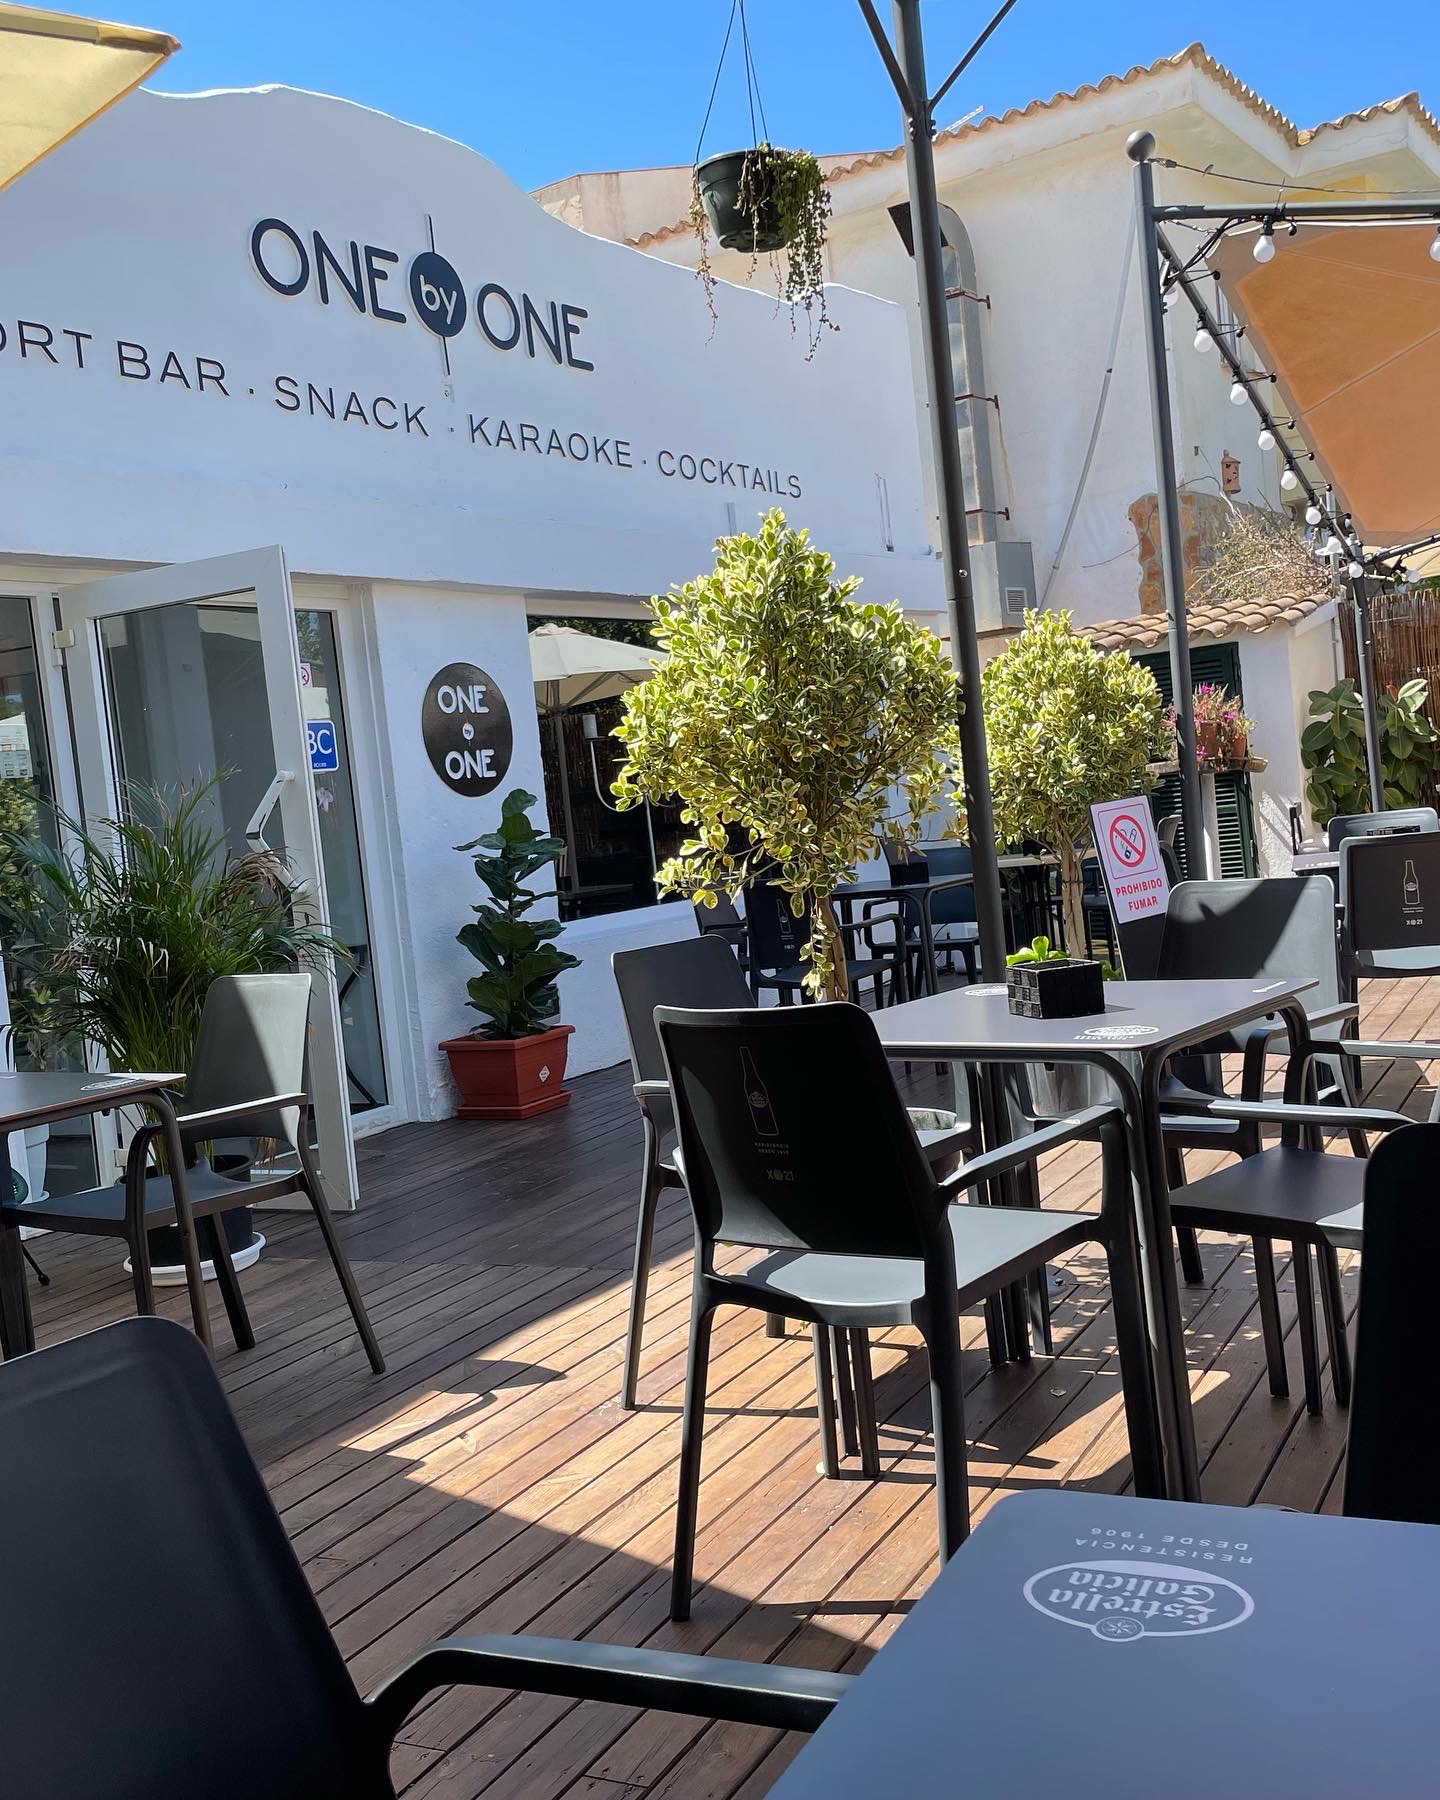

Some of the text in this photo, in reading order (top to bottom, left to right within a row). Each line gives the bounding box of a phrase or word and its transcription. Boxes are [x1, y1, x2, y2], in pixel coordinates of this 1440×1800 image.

[250, 217, 595, 372] ONE by ONE
[0, 319, 802, 499] RT BAR SNACK KARAOKE COCKTAILS
[437, 684, 490, 714] ONE
[445, 748, 497, 780] ONE
[1115, 878, 1163, 897] PROHIBIDO
[1128, 895, 1158, 911] FUMAR
[1075, 1537, 1253, 1564] RESISTENCIA
[1090, 1527, 1249, 1550] DESDE 1906
[1068, 1570, 1215, 1605] Galicia
[1048, 1587, 1217, 1626] Estrella
